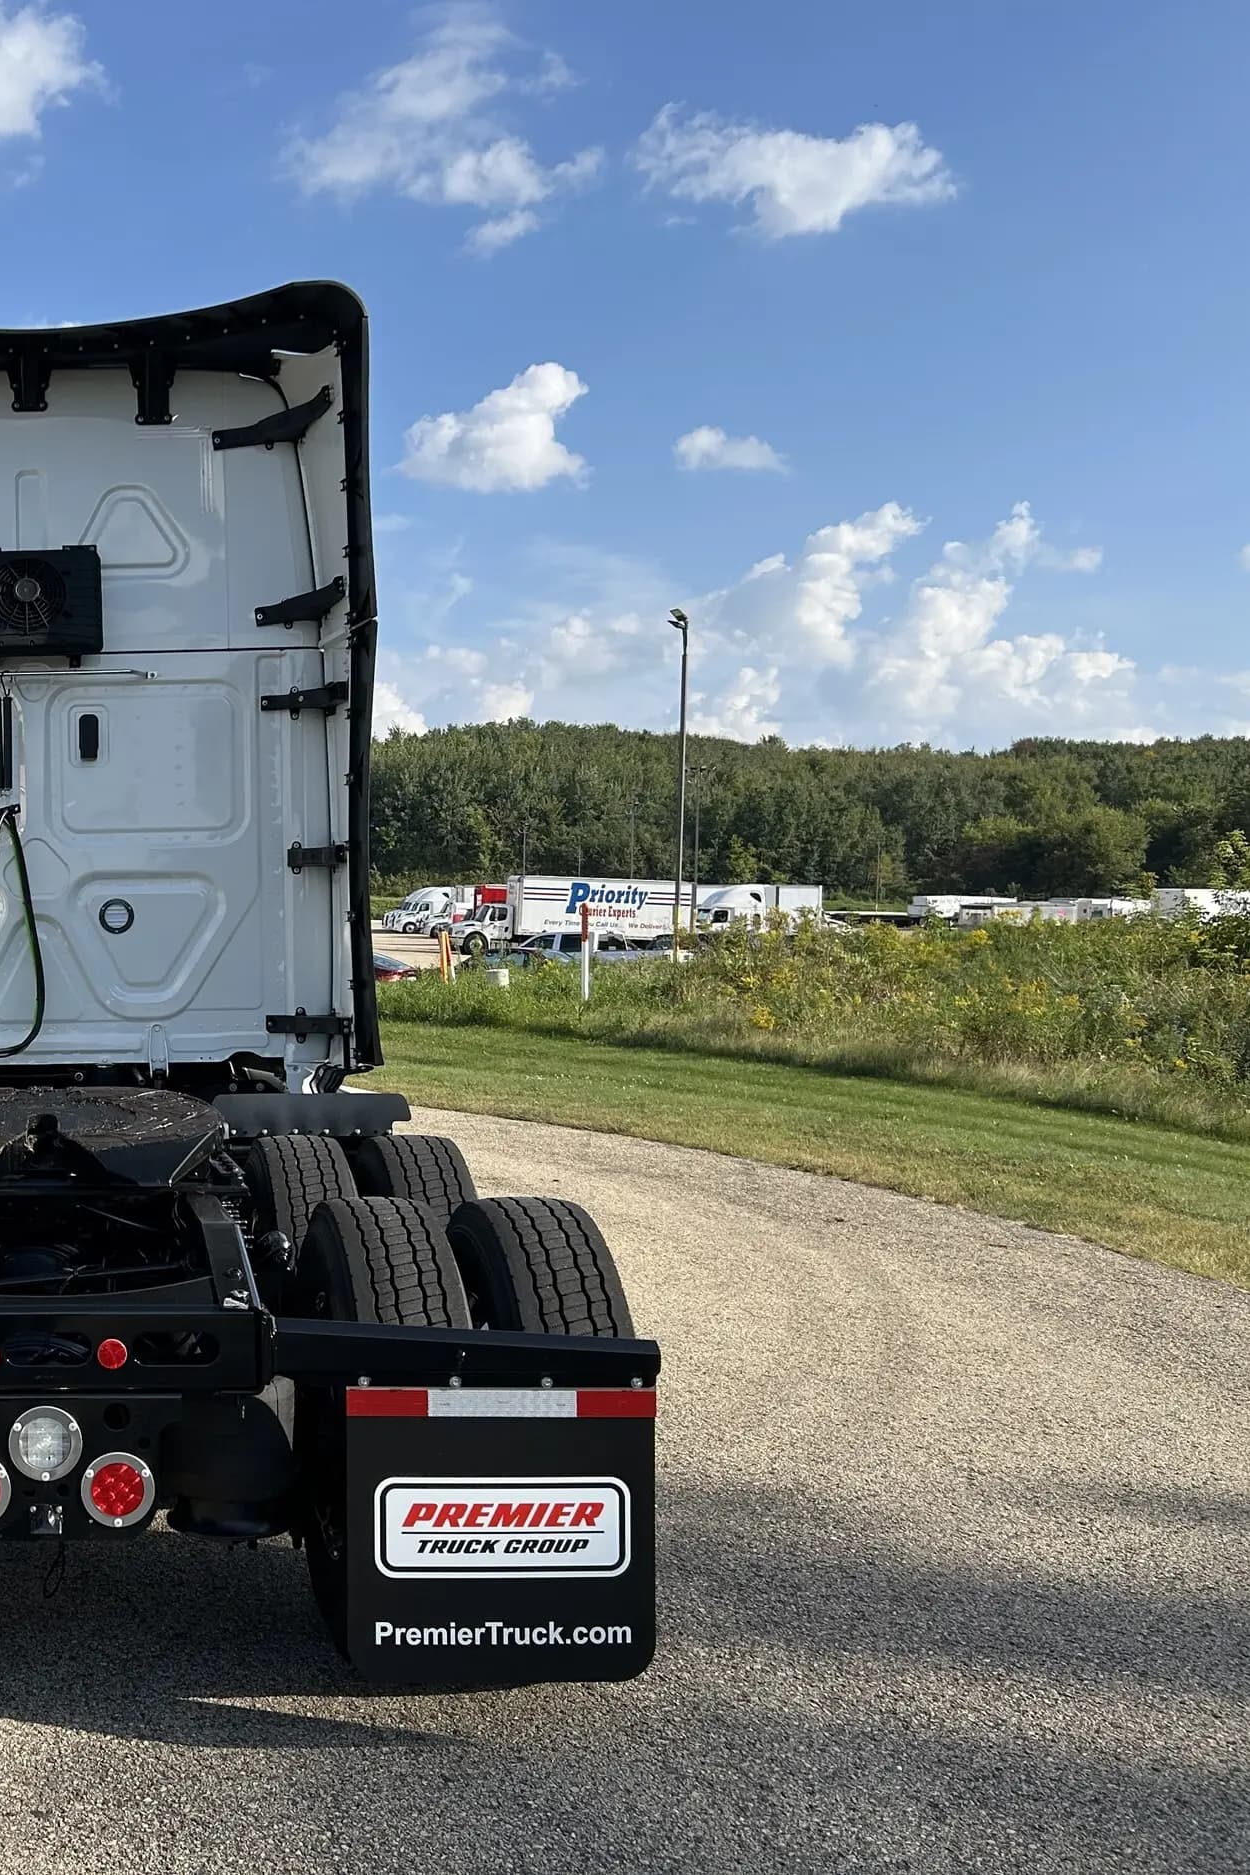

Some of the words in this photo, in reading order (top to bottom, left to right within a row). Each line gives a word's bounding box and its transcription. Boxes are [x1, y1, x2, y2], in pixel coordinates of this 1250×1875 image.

[565, 882, 648, 914] Priority
[579, 904, 607, 917] Curier
[608, 906, 637, 920] Experts
[402, 1502, 605, 1528] PREMIER
[416, 1539, 500, 1555] TRUCK
[503, 1539, 590, 1555] GROUP
[374, 1621, 632, 1646] PremierTruck.com
